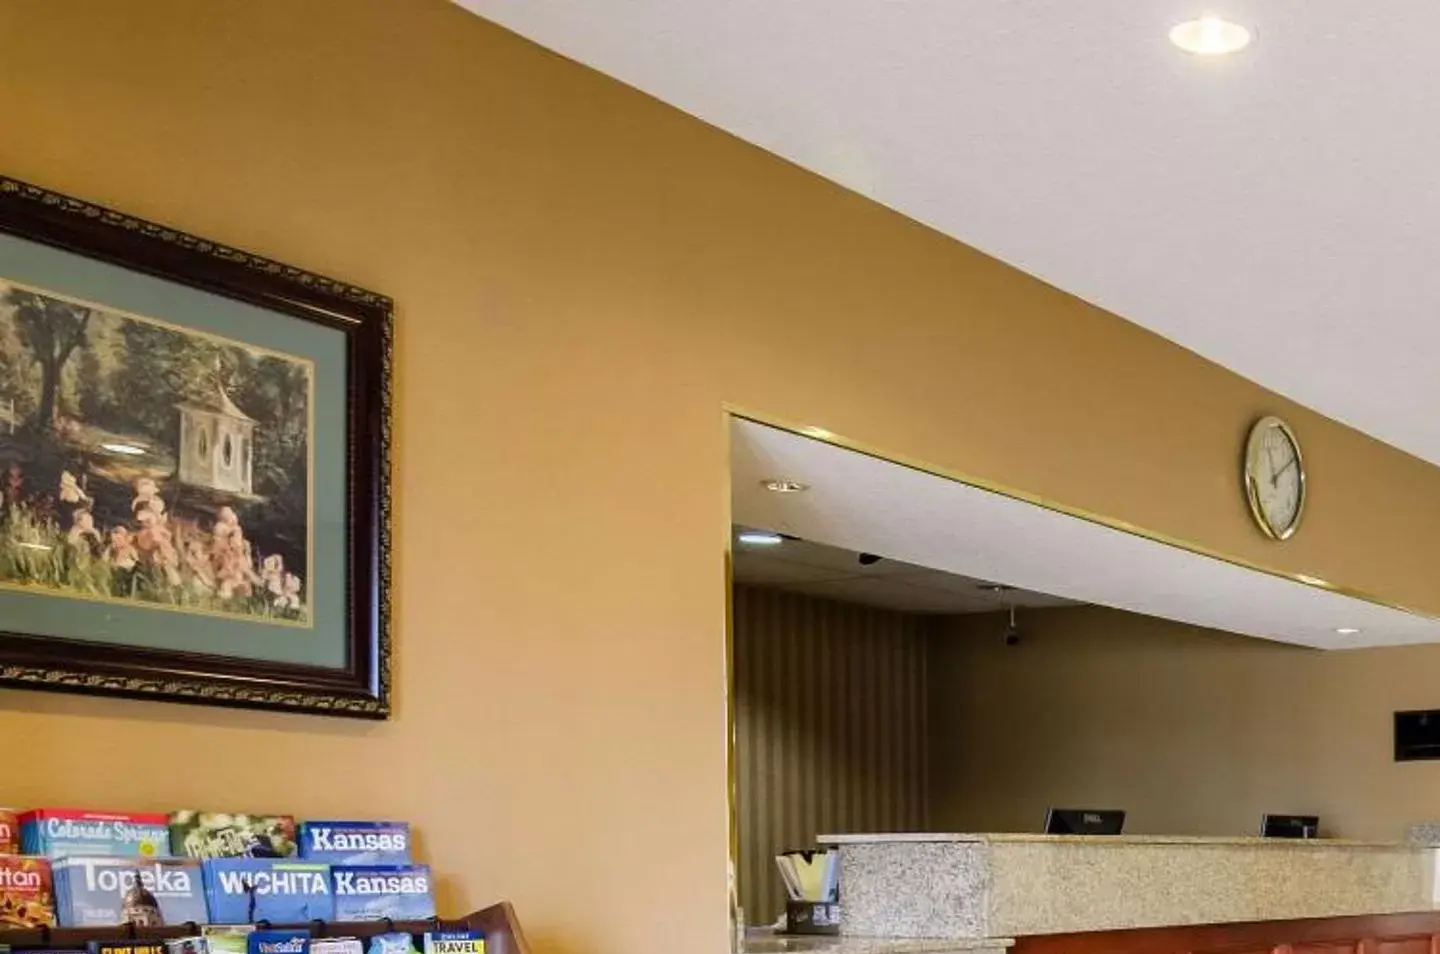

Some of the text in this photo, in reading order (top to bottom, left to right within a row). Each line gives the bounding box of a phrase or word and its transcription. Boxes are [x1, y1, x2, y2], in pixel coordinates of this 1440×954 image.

[48, 817, 111, 839] Colorado
[310, 828, 406, 850] Kansas
[83, 861, 192, 898] Topeka
[219, 872, 329, 894] WICHITA
[334, 872, 429, 894] Kansas
[434, 942, 478, 954] TRAVEL
